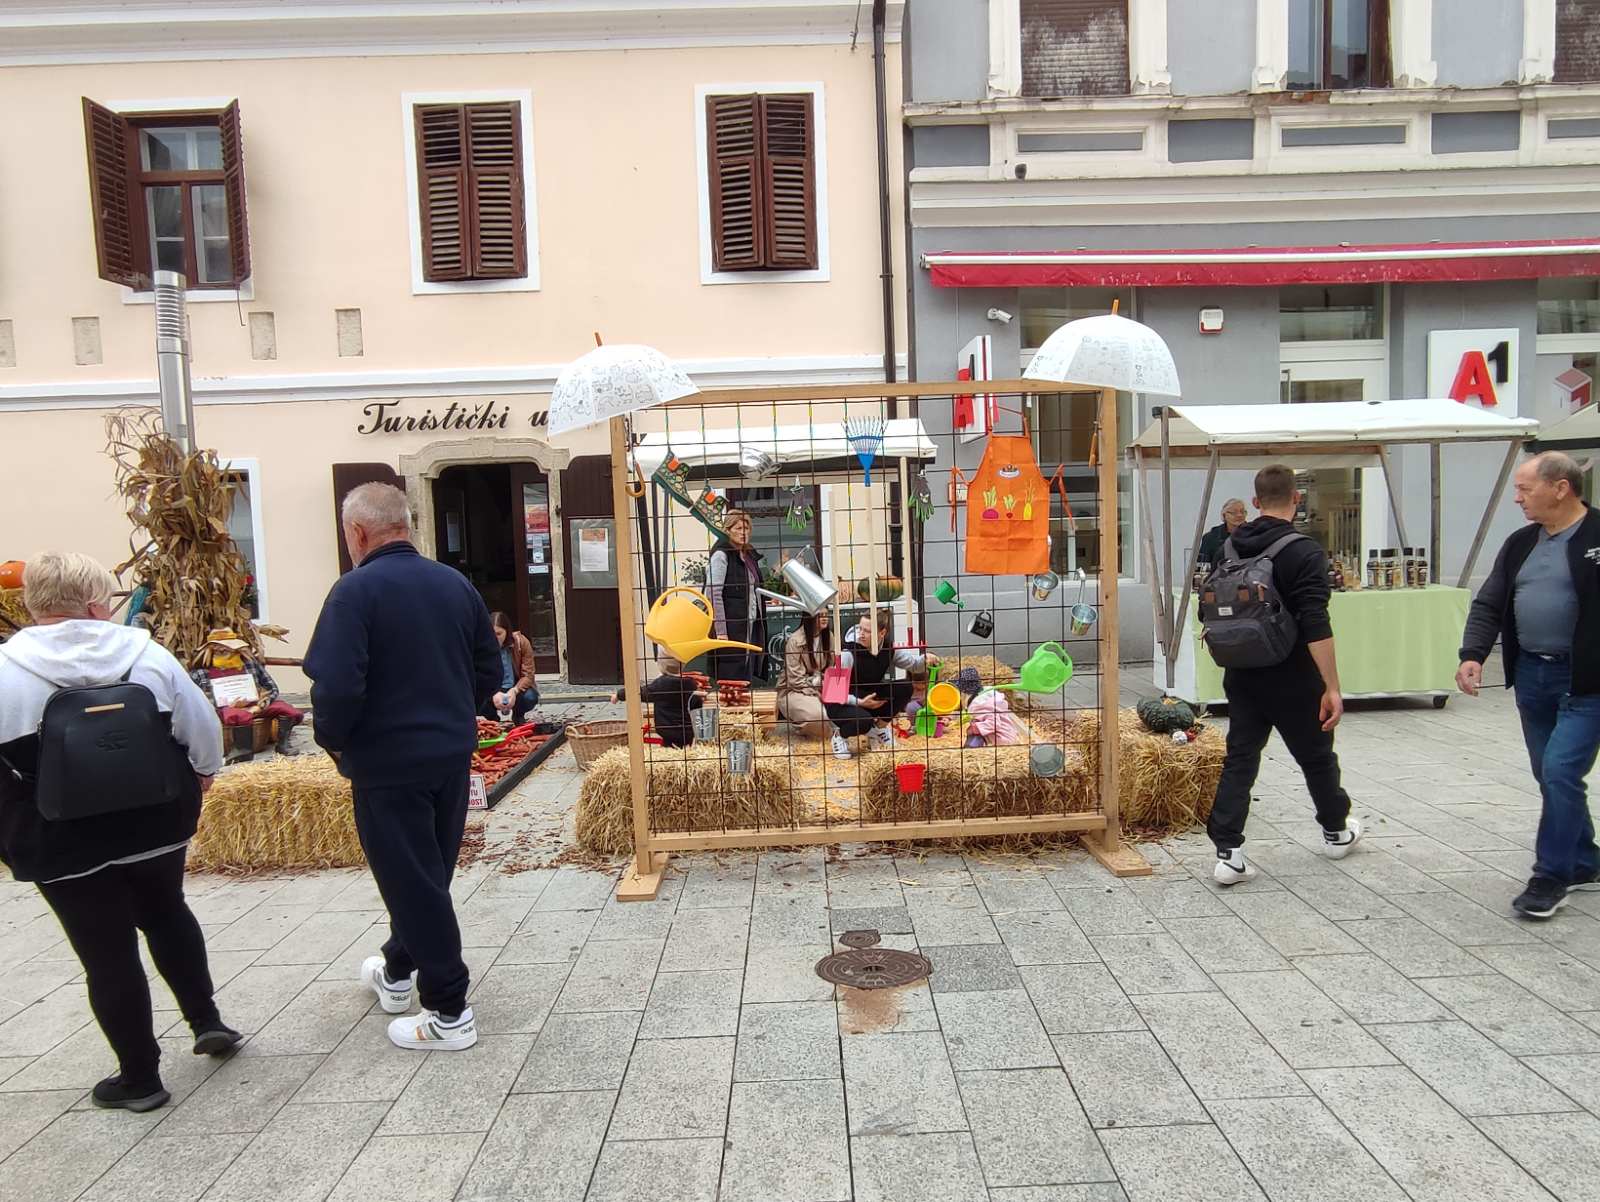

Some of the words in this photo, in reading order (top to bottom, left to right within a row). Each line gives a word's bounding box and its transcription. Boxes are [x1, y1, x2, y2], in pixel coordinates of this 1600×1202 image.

[1448, 341, 1509, 406] A1
[357, 400, 510, 435] Turistički
[528, 409, 549, 428] u
